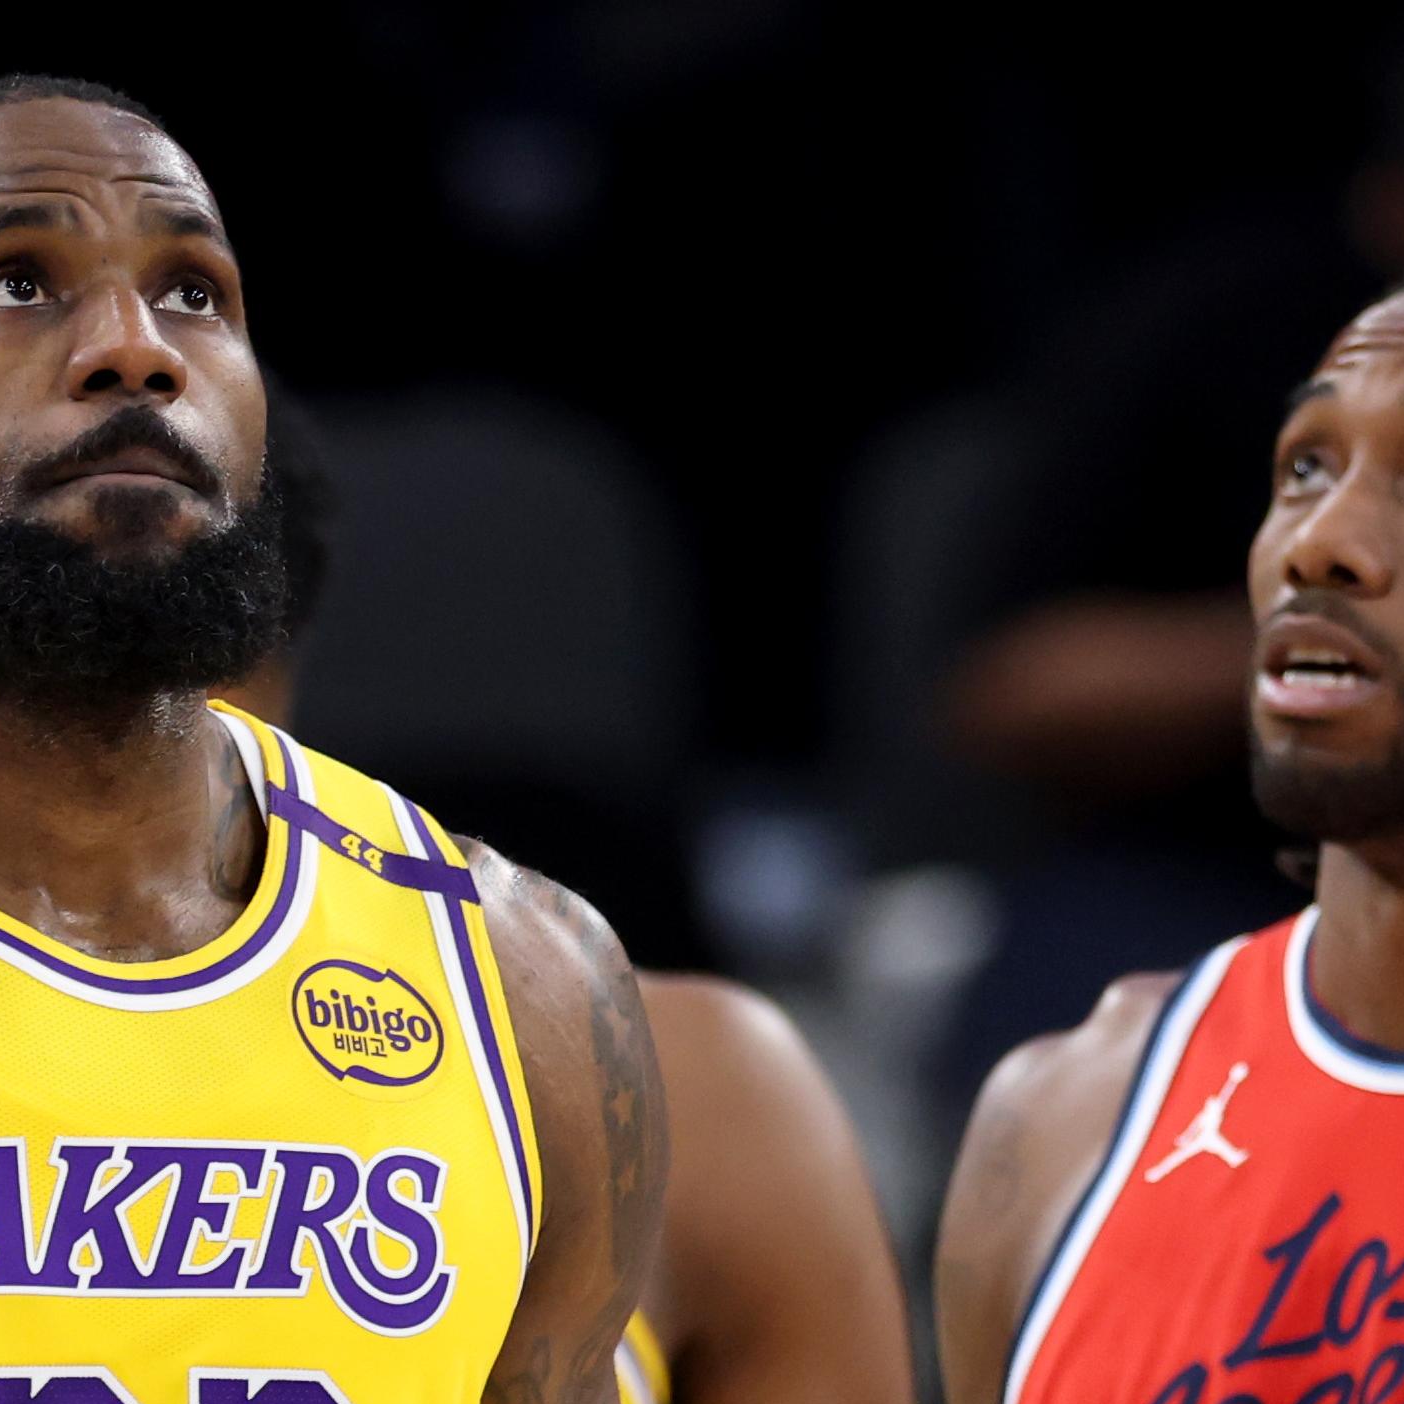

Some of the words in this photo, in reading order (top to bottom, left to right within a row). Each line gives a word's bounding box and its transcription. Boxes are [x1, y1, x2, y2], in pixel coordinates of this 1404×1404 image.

[339, 832, 384, 874] 44
[303, 987, 432, 1053] bibigo
[333, 1031, 388, 1058] 비비고
